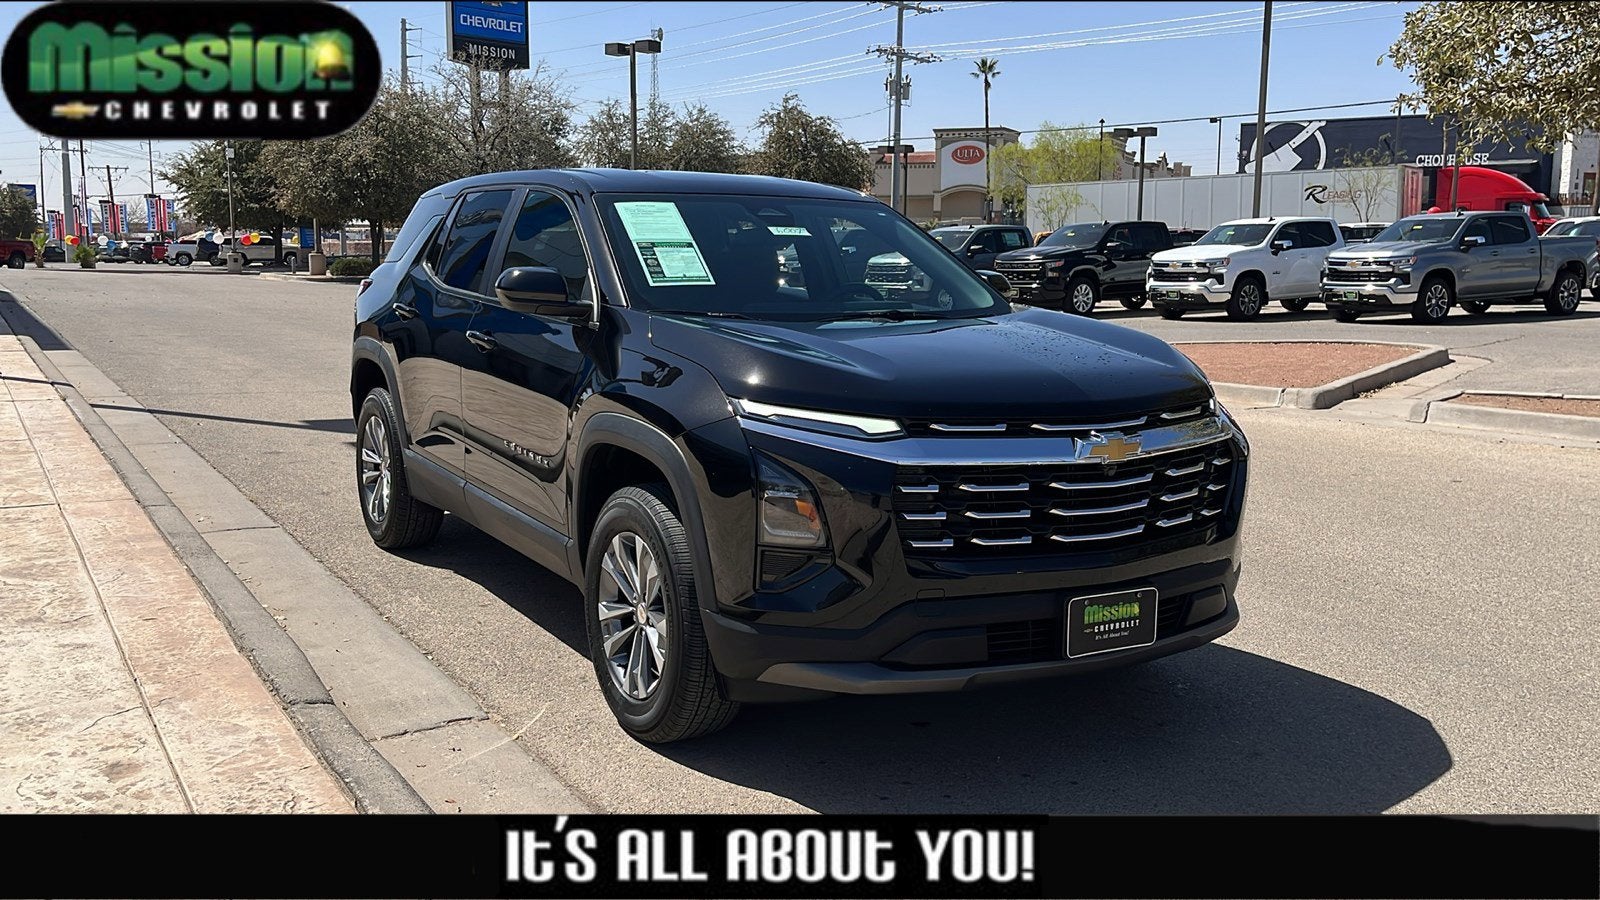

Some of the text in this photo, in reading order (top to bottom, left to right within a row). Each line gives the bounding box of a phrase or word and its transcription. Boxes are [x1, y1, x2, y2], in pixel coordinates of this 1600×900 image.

[460, 14, 523, 33] CHEVROLET
[468, 43, 516, 59] MISSION
[957, 149, 980, 158] ULTA
[1416, 153, 1489, 167] CHOHUSE
[503, 440, 549, 468] EQUINOX
[1084, 602, 1140, 624] Mission
[1094, 619, 1140, 633] CHEVROLET
